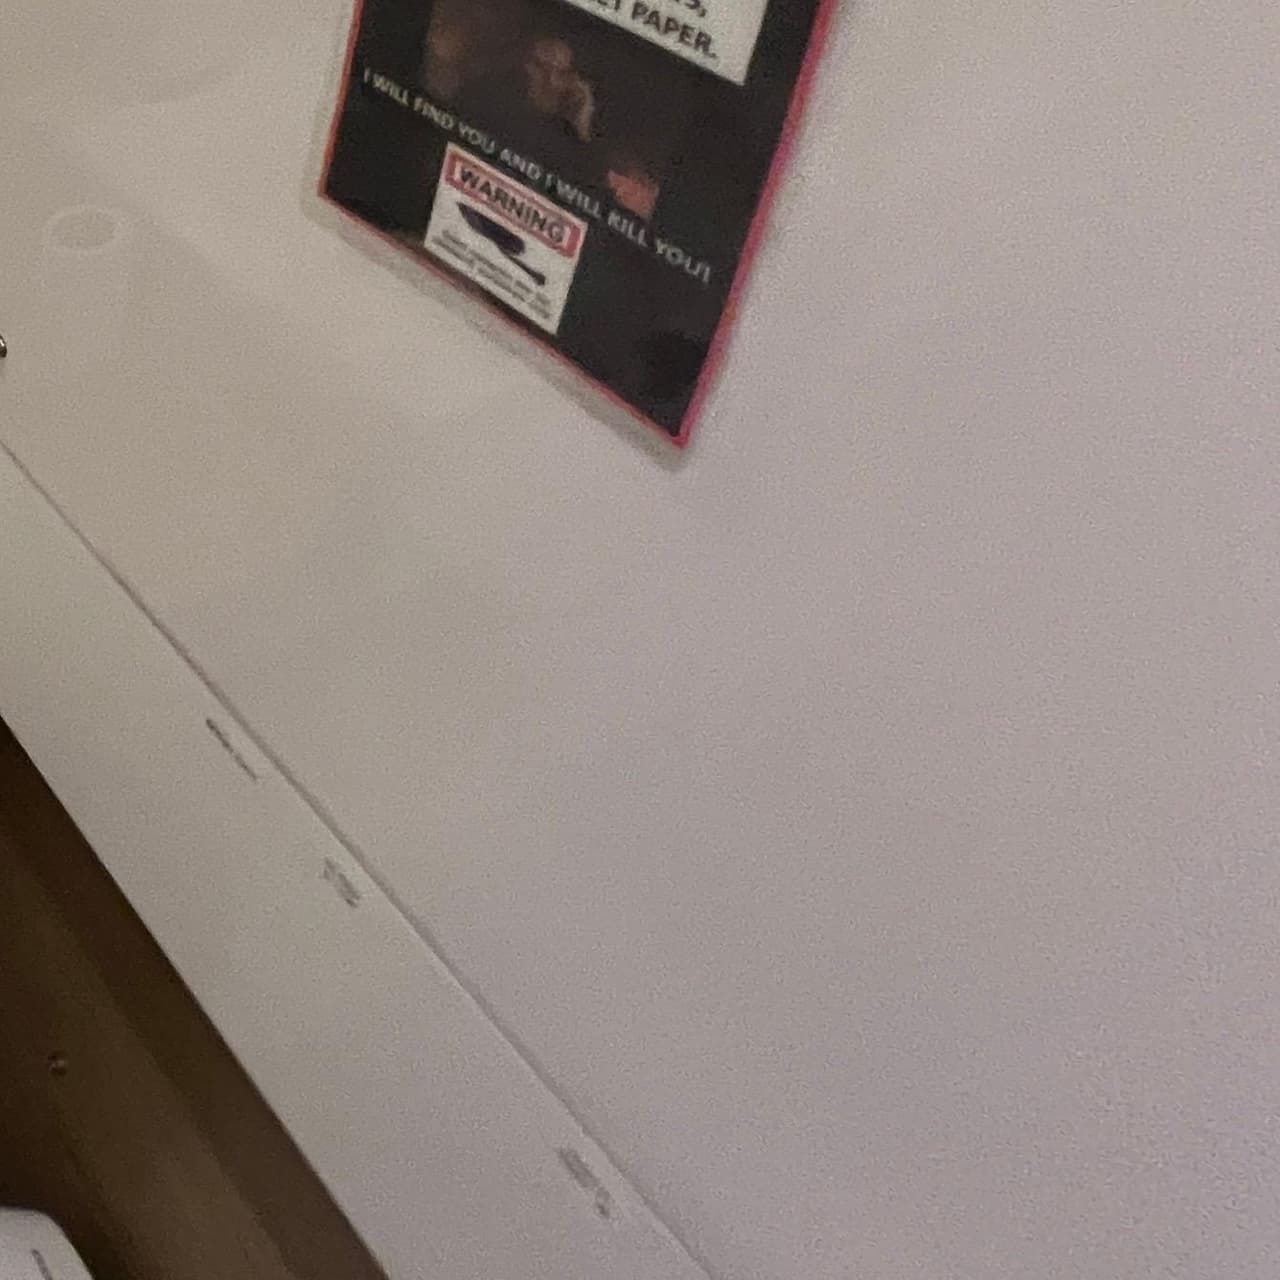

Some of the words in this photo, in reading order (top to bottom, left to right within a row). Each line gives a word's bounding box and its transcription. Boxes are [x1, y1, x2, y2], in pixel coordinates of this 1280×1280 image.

[632, 0, 717, 58] PAPER.
[363, 67, 371, 83] I
[372, 73, 409, 106] WILL
[413, 96, 454, 130] FIND
[458, 122, 496, 154] YOU
[500, 148, 541, 180] AND
[545, 173, 553, 189] I
[556, 178, 603, 219] WILL
[608, 209, 648, 248] KILL
[460, 166, 565, 243] WARNING
